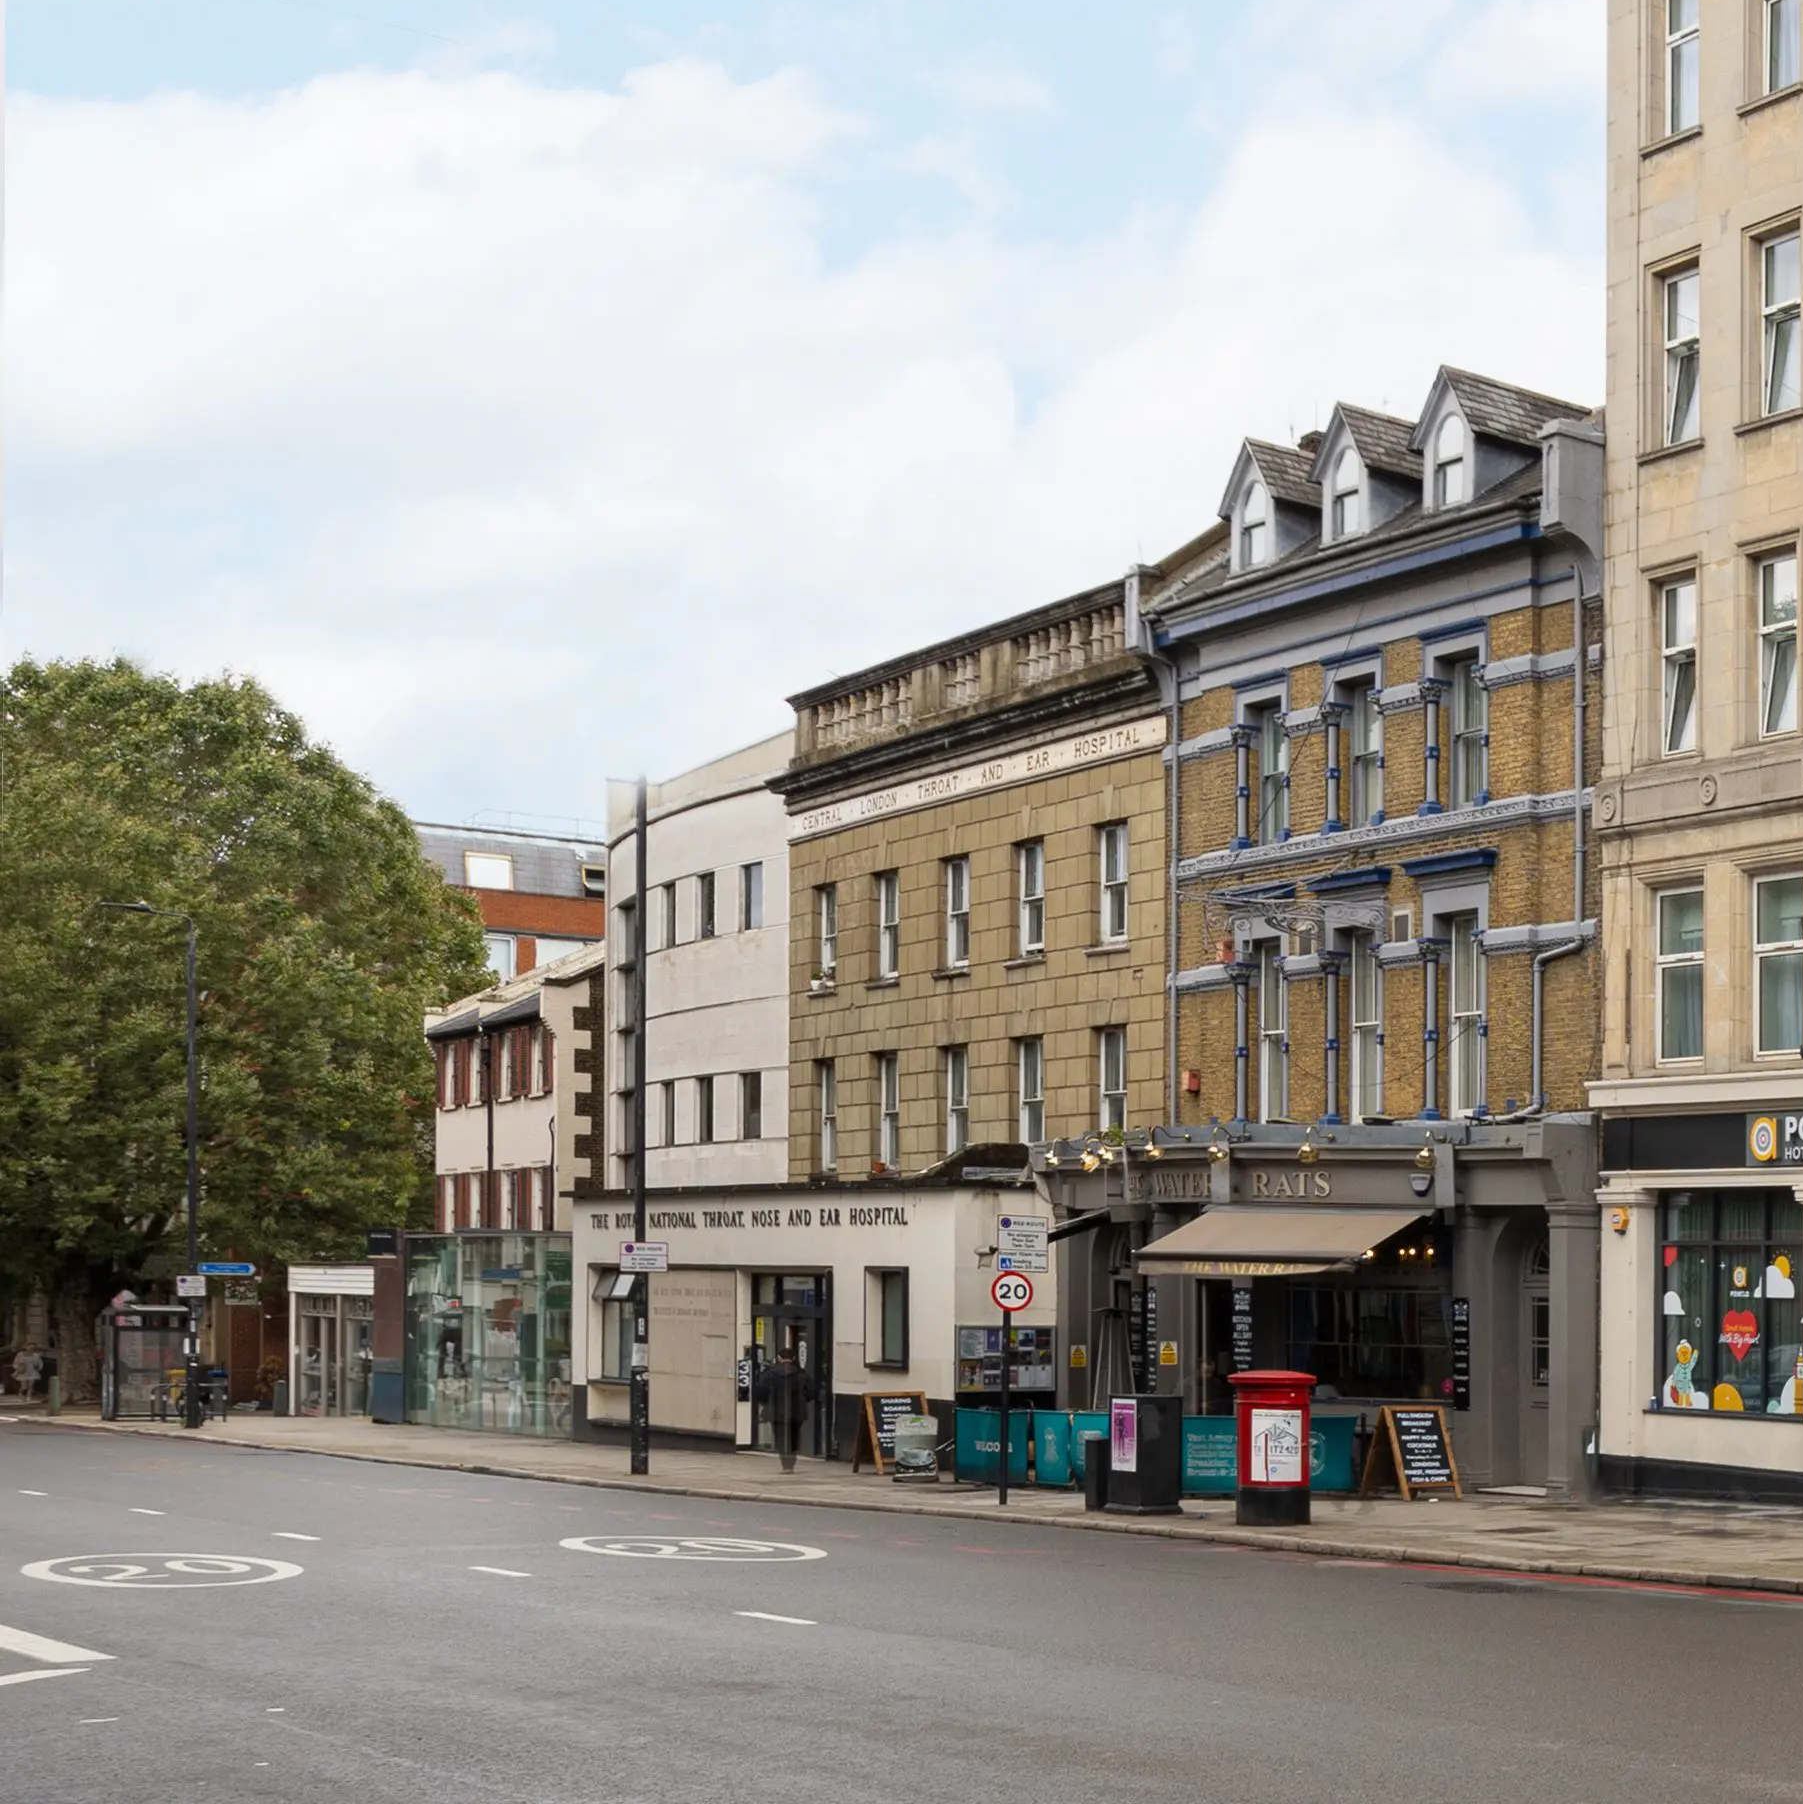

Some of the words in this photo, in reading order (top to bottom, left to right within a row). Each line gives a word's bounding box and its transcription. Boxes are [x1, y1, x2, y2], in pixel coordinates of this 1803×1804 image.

[801, 805, 842, 831] CENTRAL
[860, 791, 898, 816] LONDON
[917, 774, 960, 800] THROAT
[980, 763, 1004, 784] AND
[1026, 750, 1051, 771] EAR
[1073, 730, 1141, 760] HOSPITAL
[1251, 1170, 1333, 1197] RATS
[591, 1213, 609, 1230] THE
[615, 1212, 636, 1229] ROYA
[649, 1211, 697, 1229] NATIONAL
[752, 1209, 781, 1228] NOSE
[787, 1208, 812, 1227] AND
[819, 1207, 841, 1227] EAR
[849, 1206, 909, 1227] HOSPITAL
[999, 1283, 1028, 1300] 20
[607, 1539, 778, 1556] 20
[72, 1560, 248, 1583] 20
